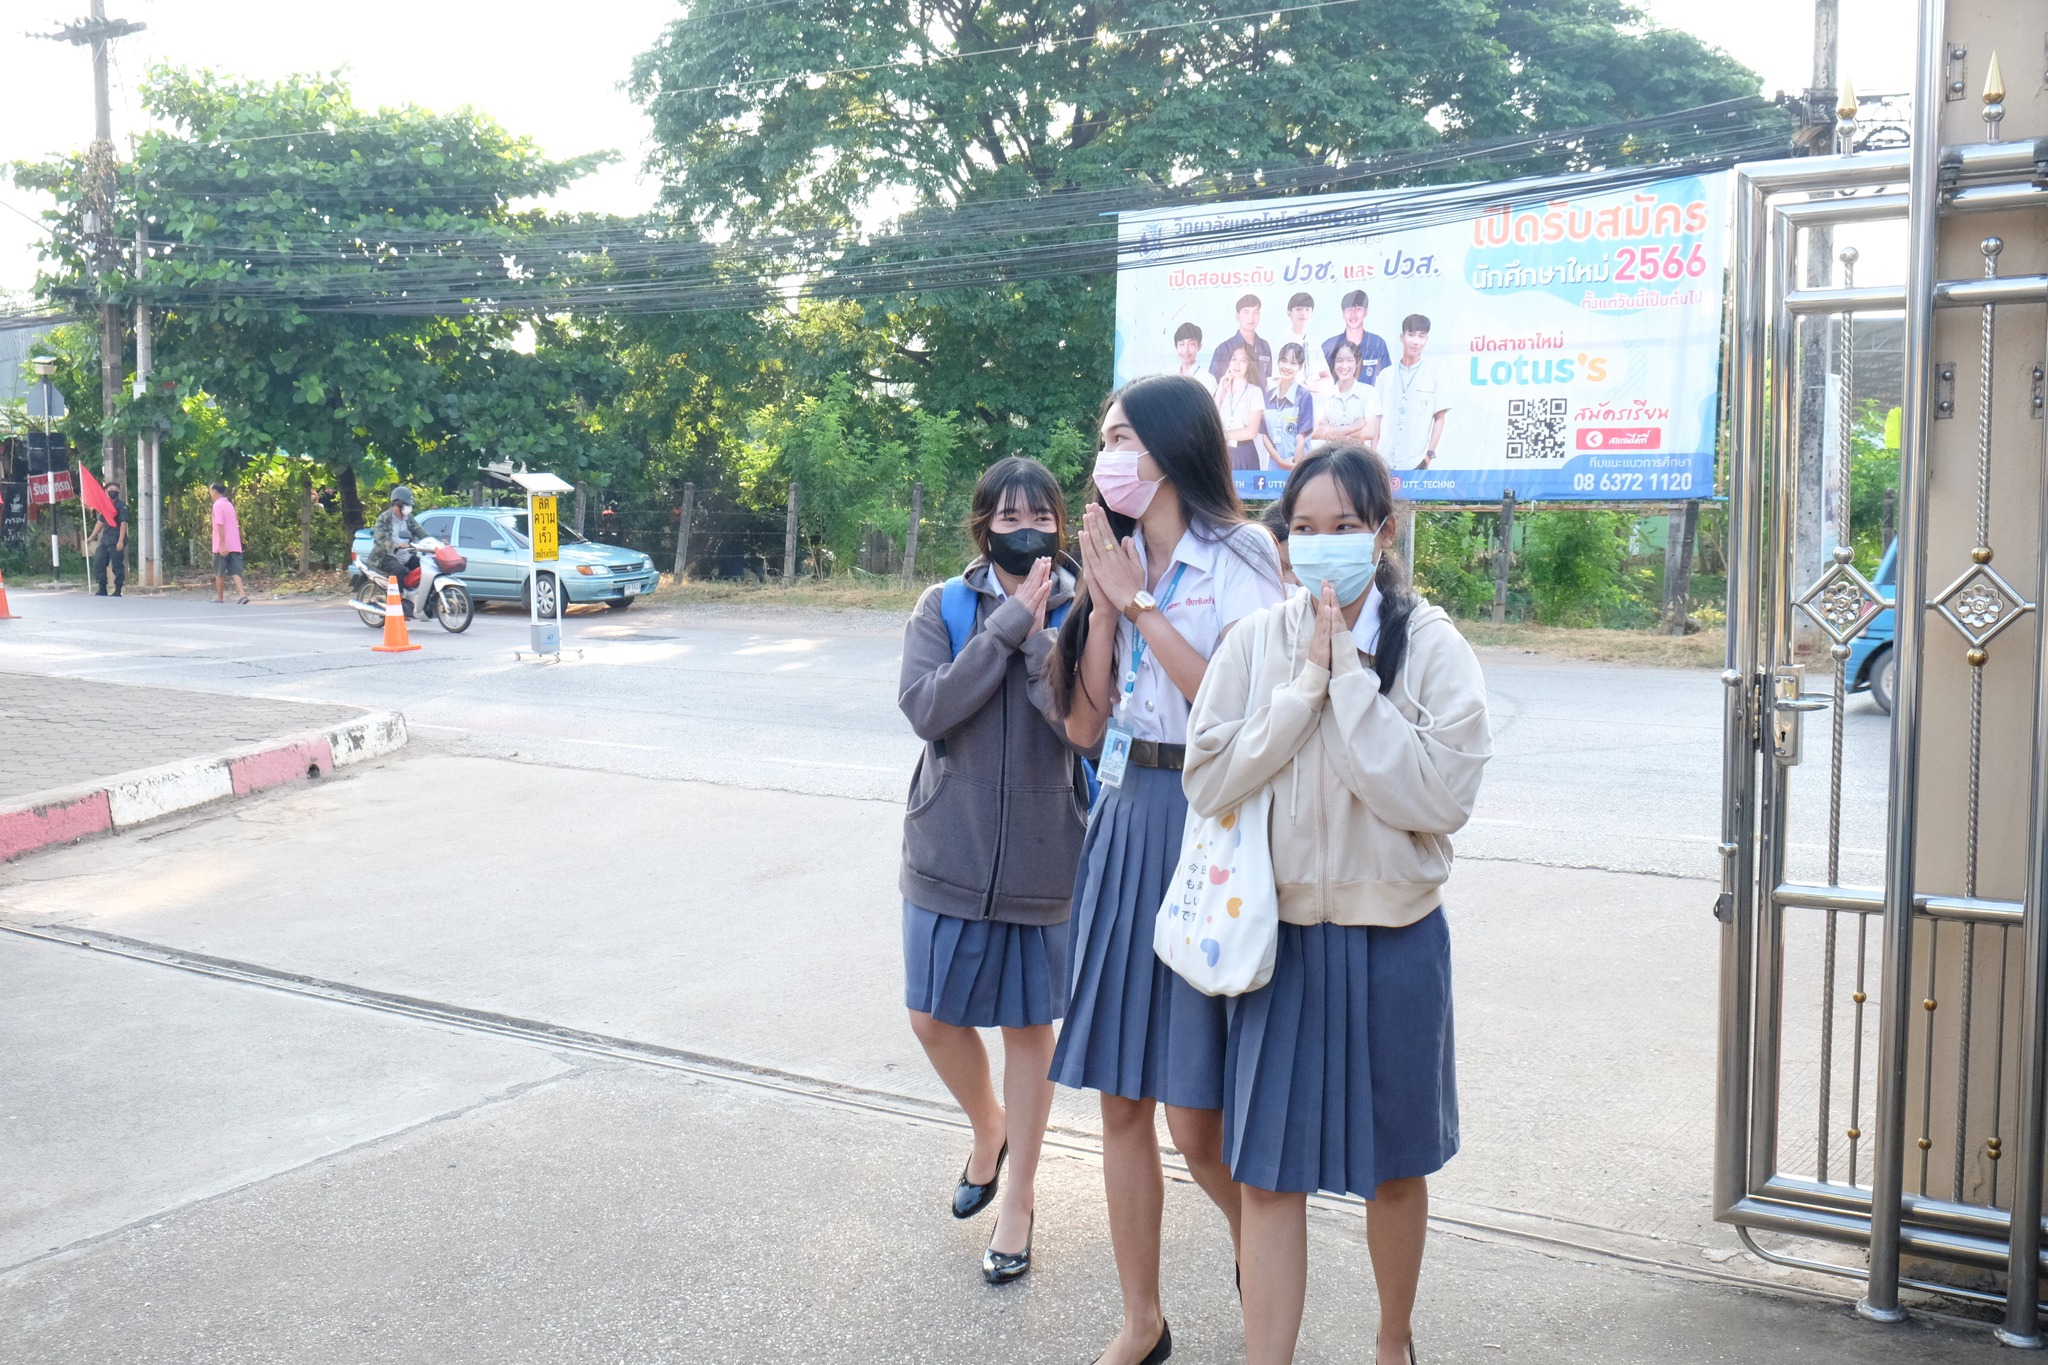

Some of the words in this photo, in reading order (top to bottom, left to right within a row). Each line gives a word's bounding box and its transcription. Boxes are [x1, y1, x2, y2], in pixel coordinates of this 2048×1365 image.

[1473, 194, 1707, 247] เปิดรับสมัคร
[1168, 265, 1275, 288] เปิดสอนระดับ
[1283, 256, 1336, 283] ปวช.
[1343, 263, 1375, 280] และ
[1383, 249, 1440, 278] ปวส.
[1472, 255, 1610, 289] นักศึกษาใหม่
[1614, 243, 1707, 282] 2566
[1470, 330, 1565, 353] เปิดสาขาใหม่
[1470, 352, 1608, 386] Lotus's
[1574, 399, 1670, 423] สมัครเรียน
[1402, 480, 1456, 489] UTT_TECHNO
[1573, 473, 1595, 491] 08
[1600, 473, 1643, 491] 6372
[1649, 472, 1693, 491] 1120
[539, 498, 550, 510] ลด
[534, 513, 556, 525] ความ
[538, 526, 552, 544] เร็ว
